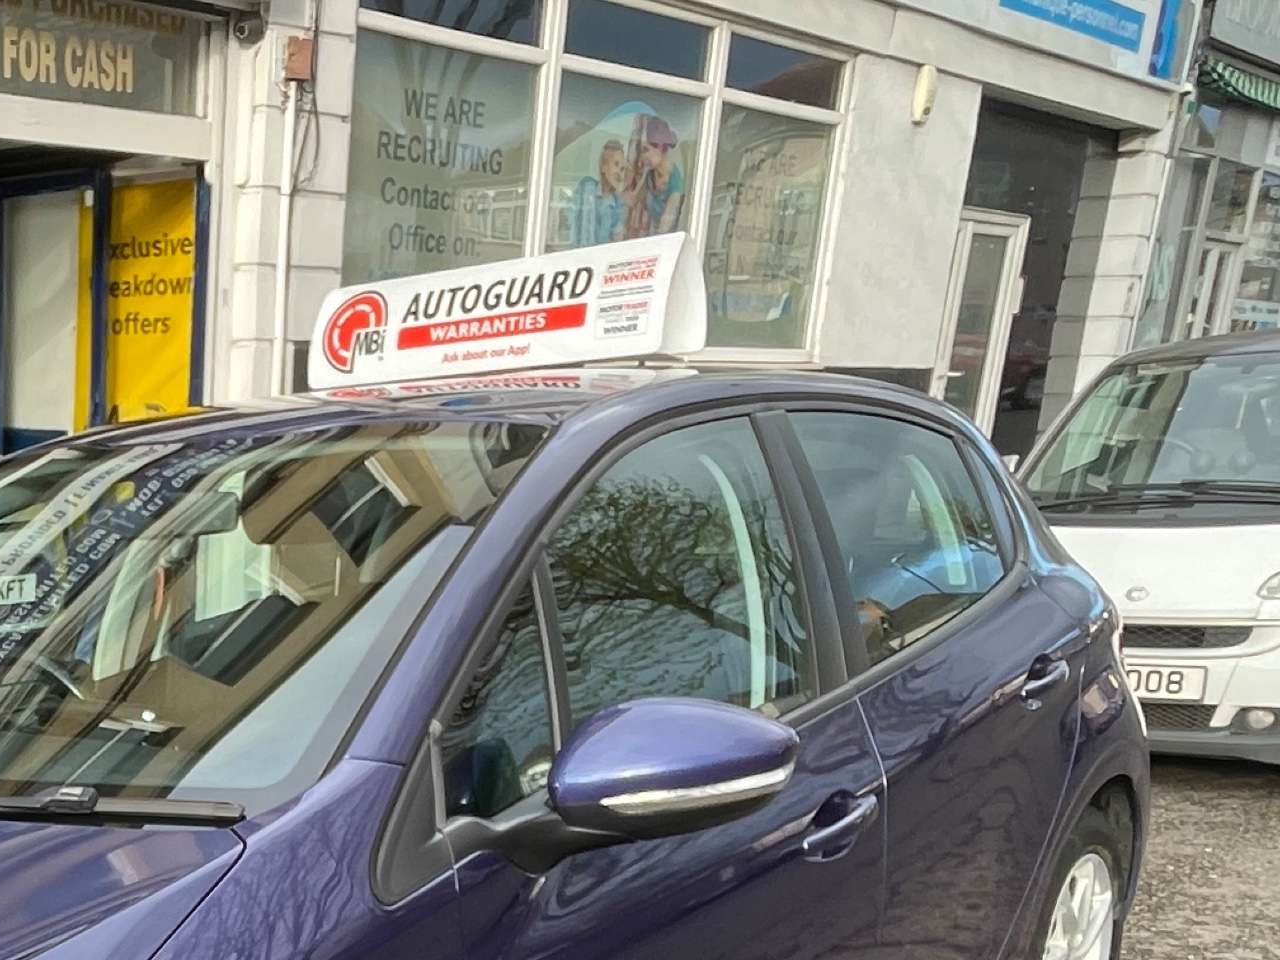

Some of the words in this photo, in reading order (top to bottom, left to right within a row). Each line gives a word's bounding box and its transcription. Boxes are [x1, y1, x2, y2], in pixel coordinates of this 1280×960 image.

[2, 25, 57, 84] FOR
[64, 34, 134, 94] CASH
[404, 88, 439, 121] WE
[443, 96, 486, 129] ARE
[376, 130, 503, 175] RECRUITING
[381, 177, 456, 212] Contact
[388, 222, 447, 253] Office
[603, 268, 655, 285] WINNER
[401, 266, 594, 323] AUTOGUARD
[111, 312, 171, 335] offers
[430, 312, 547, 342] WARRANTIES
[441, 351, 459, 364] Ask
[462, 347, 487, 361] about
[489, 346, 506, 358] our
[507, 342, 531, 358] App!
